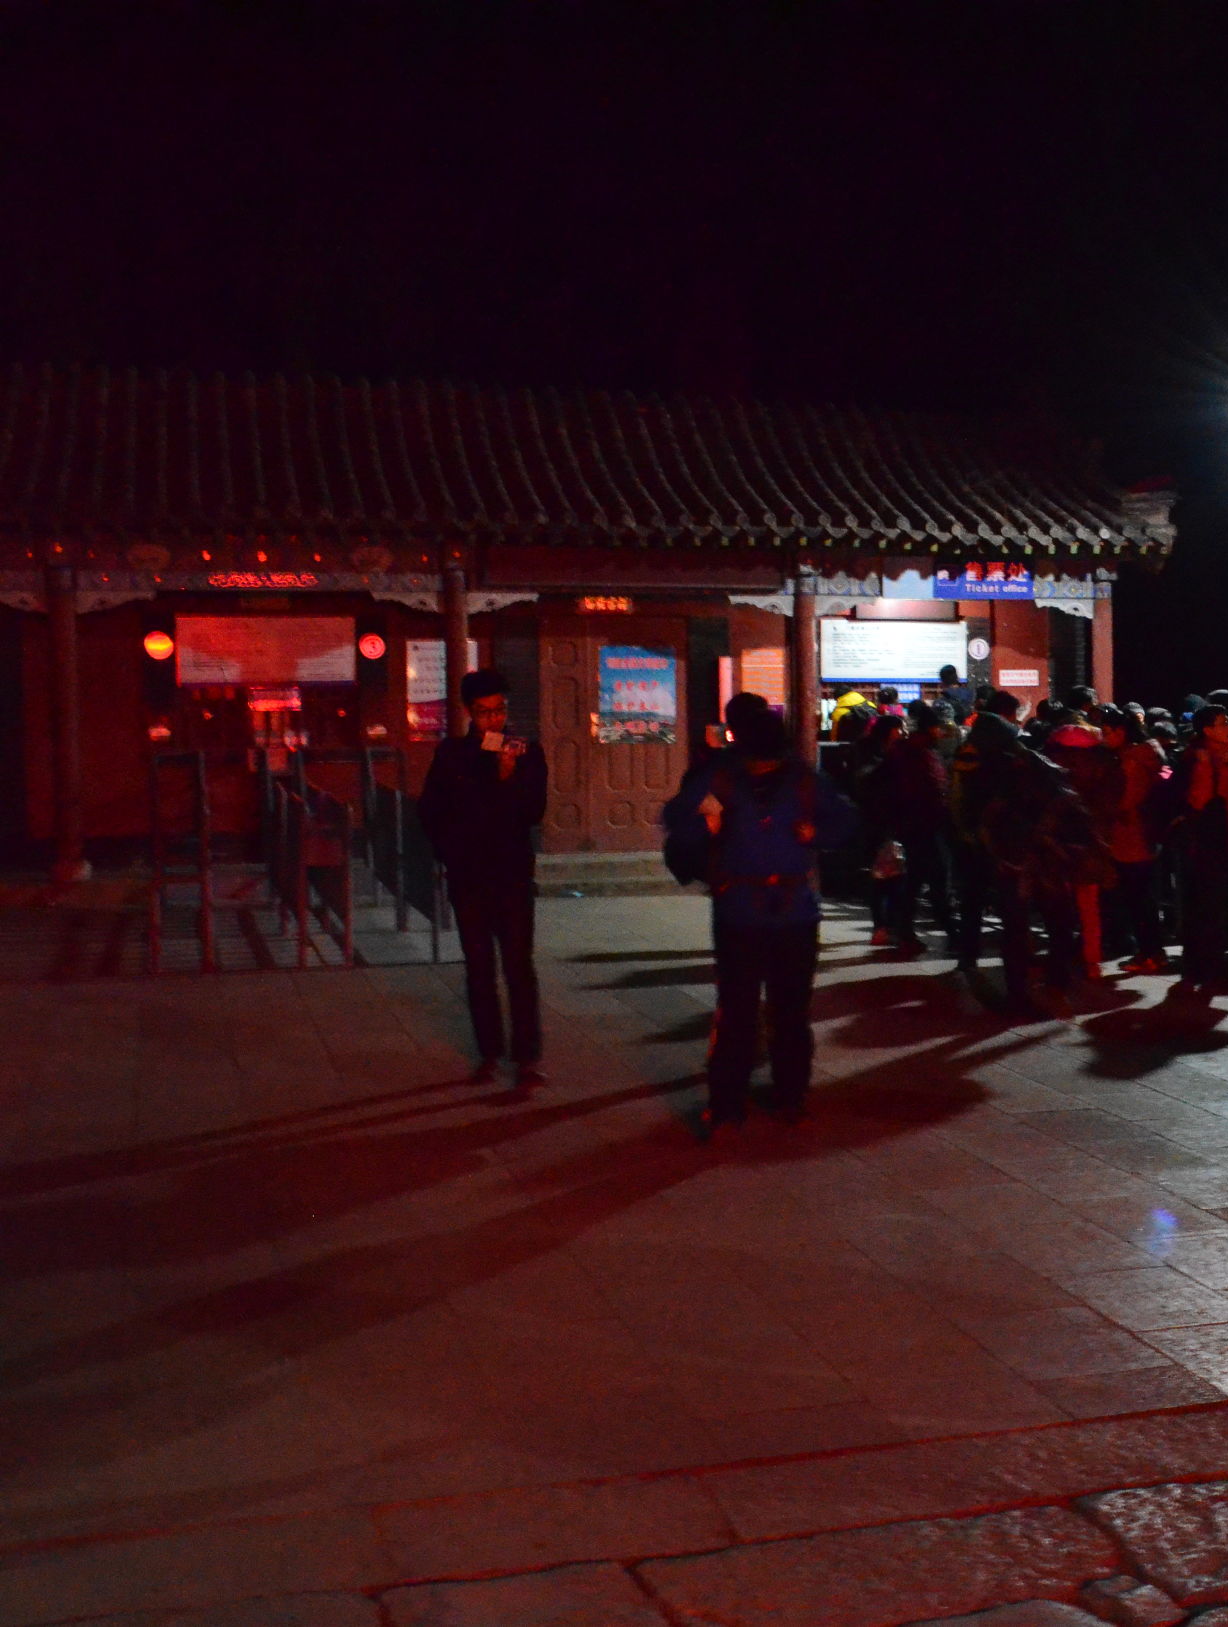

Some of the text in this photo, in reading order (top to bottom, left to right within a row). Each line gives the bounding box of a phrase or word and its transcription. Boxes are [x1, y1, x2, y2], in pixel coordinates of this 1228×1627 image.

[965, 561, 1028, 582] 售票处
[965, 583, 1000, 593] Ticket
